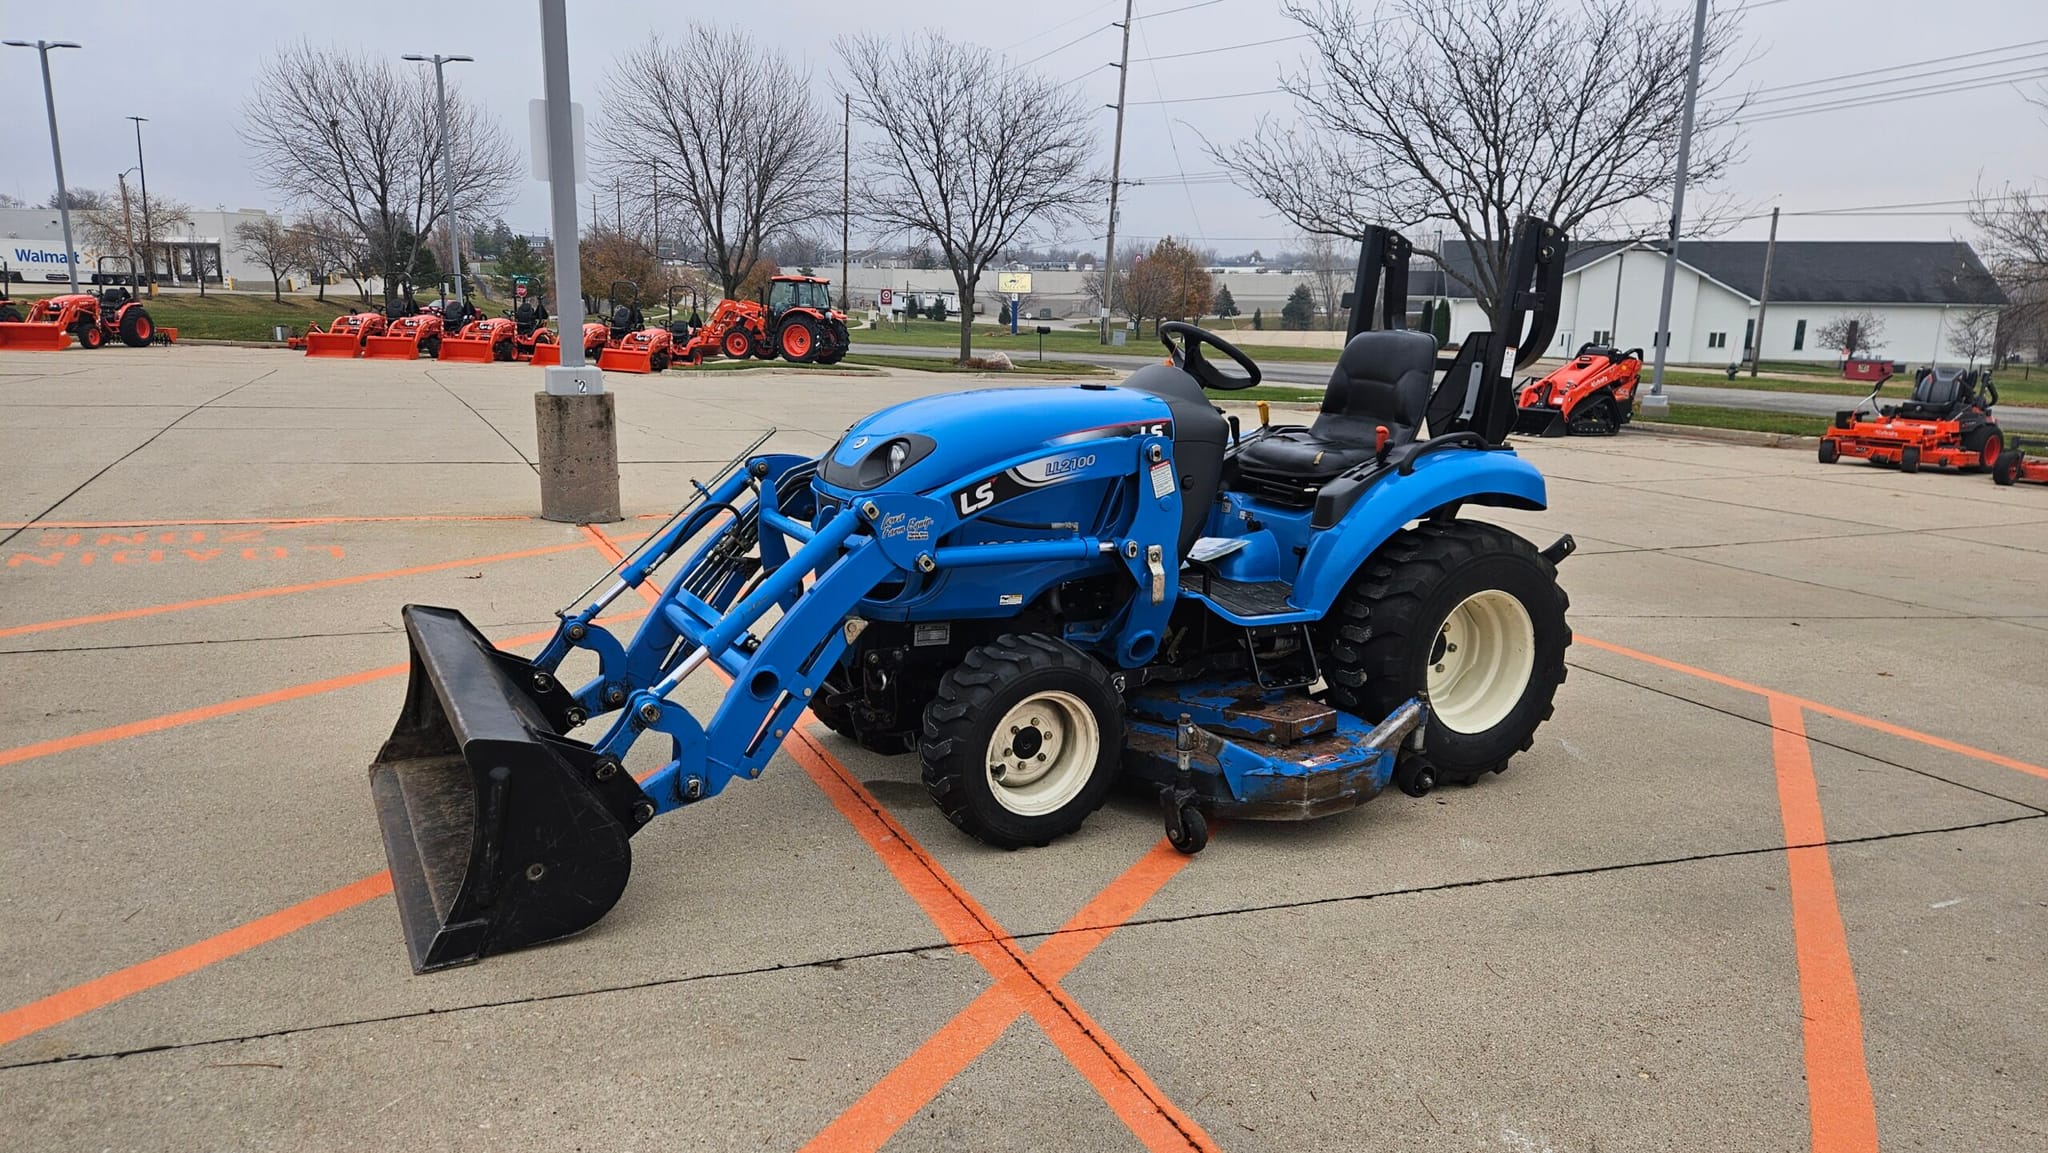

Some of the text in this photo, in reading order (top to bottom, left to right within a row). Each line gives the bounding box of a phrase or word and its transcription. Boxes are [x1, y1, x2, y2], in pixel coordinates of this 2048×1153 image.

[15, 248, 80, 264] Walmat
[579, 380, 586, 394] 2
[1045, 454, 1096, 477] LL2100
[960, 482, 994, 515] LS
